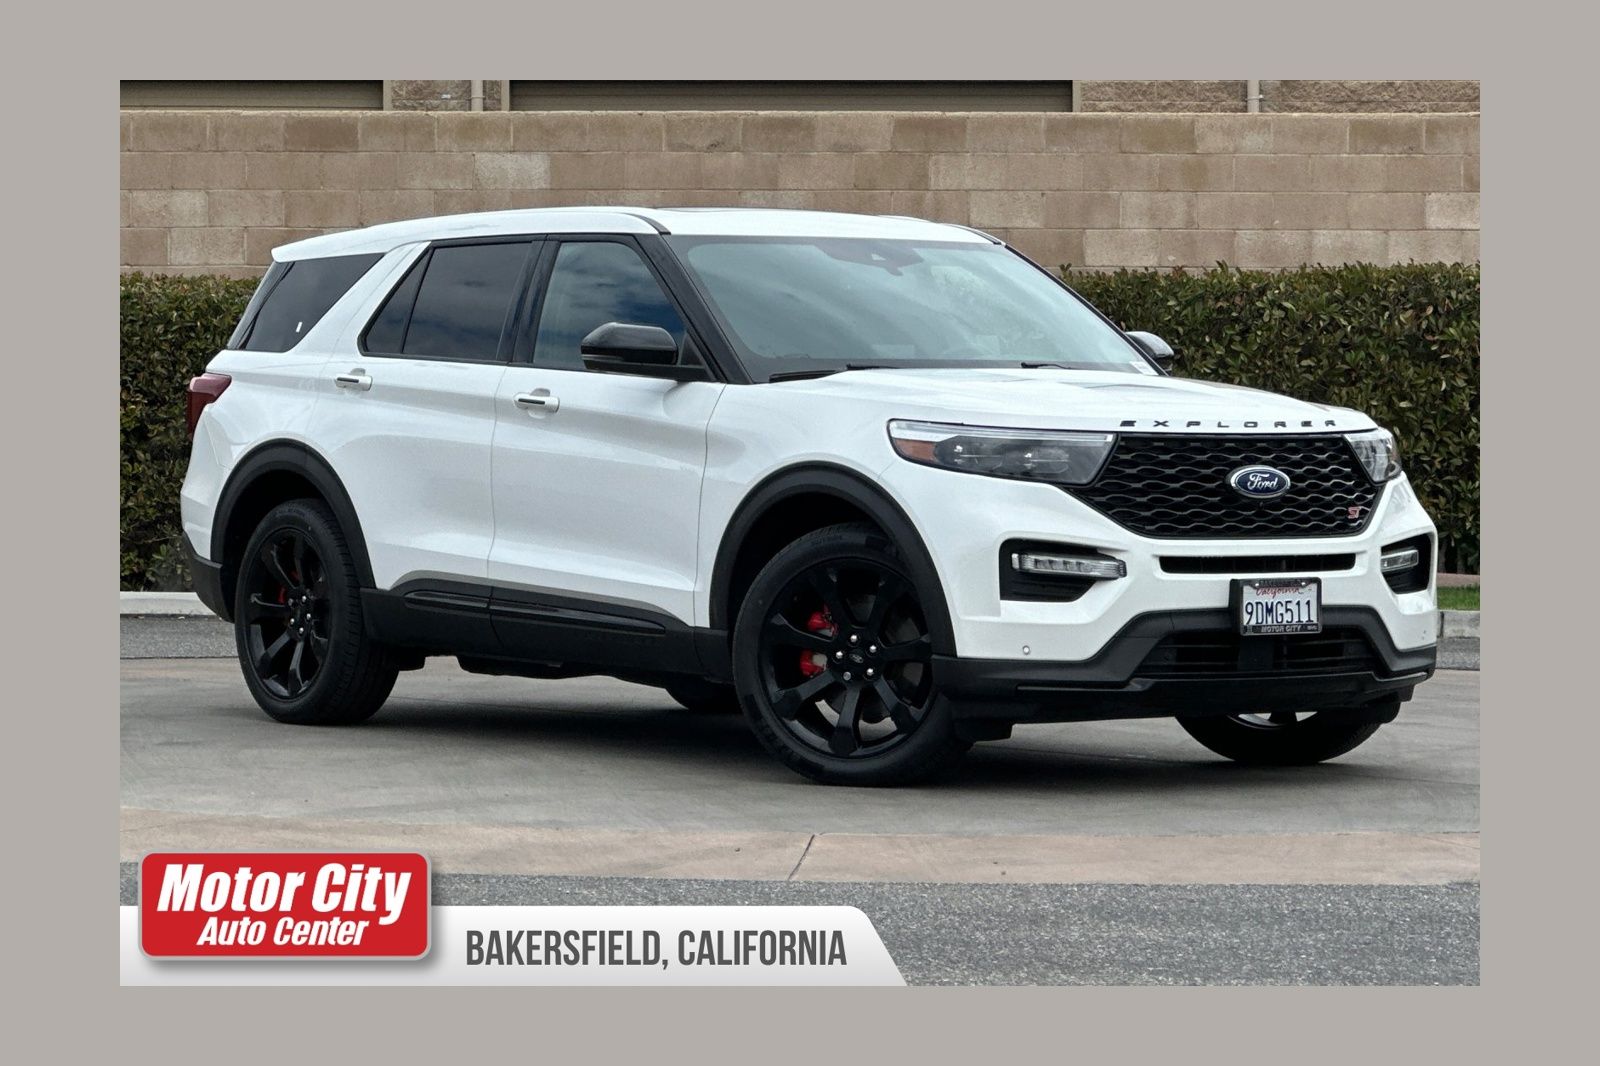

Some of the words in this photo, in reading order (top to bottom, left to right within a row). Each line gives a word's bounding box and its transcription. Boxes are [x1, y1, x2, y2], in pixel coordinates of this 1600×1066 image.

[1119, 419, 1337, 428] EXPLORER
[1247, 472, 1278, 490] Ford
[1245, 599, 1314, 625] 9DMG511
[1260, 625, 1285, 633] MOTOR
[1285, 624, 1302, 632] CITY
